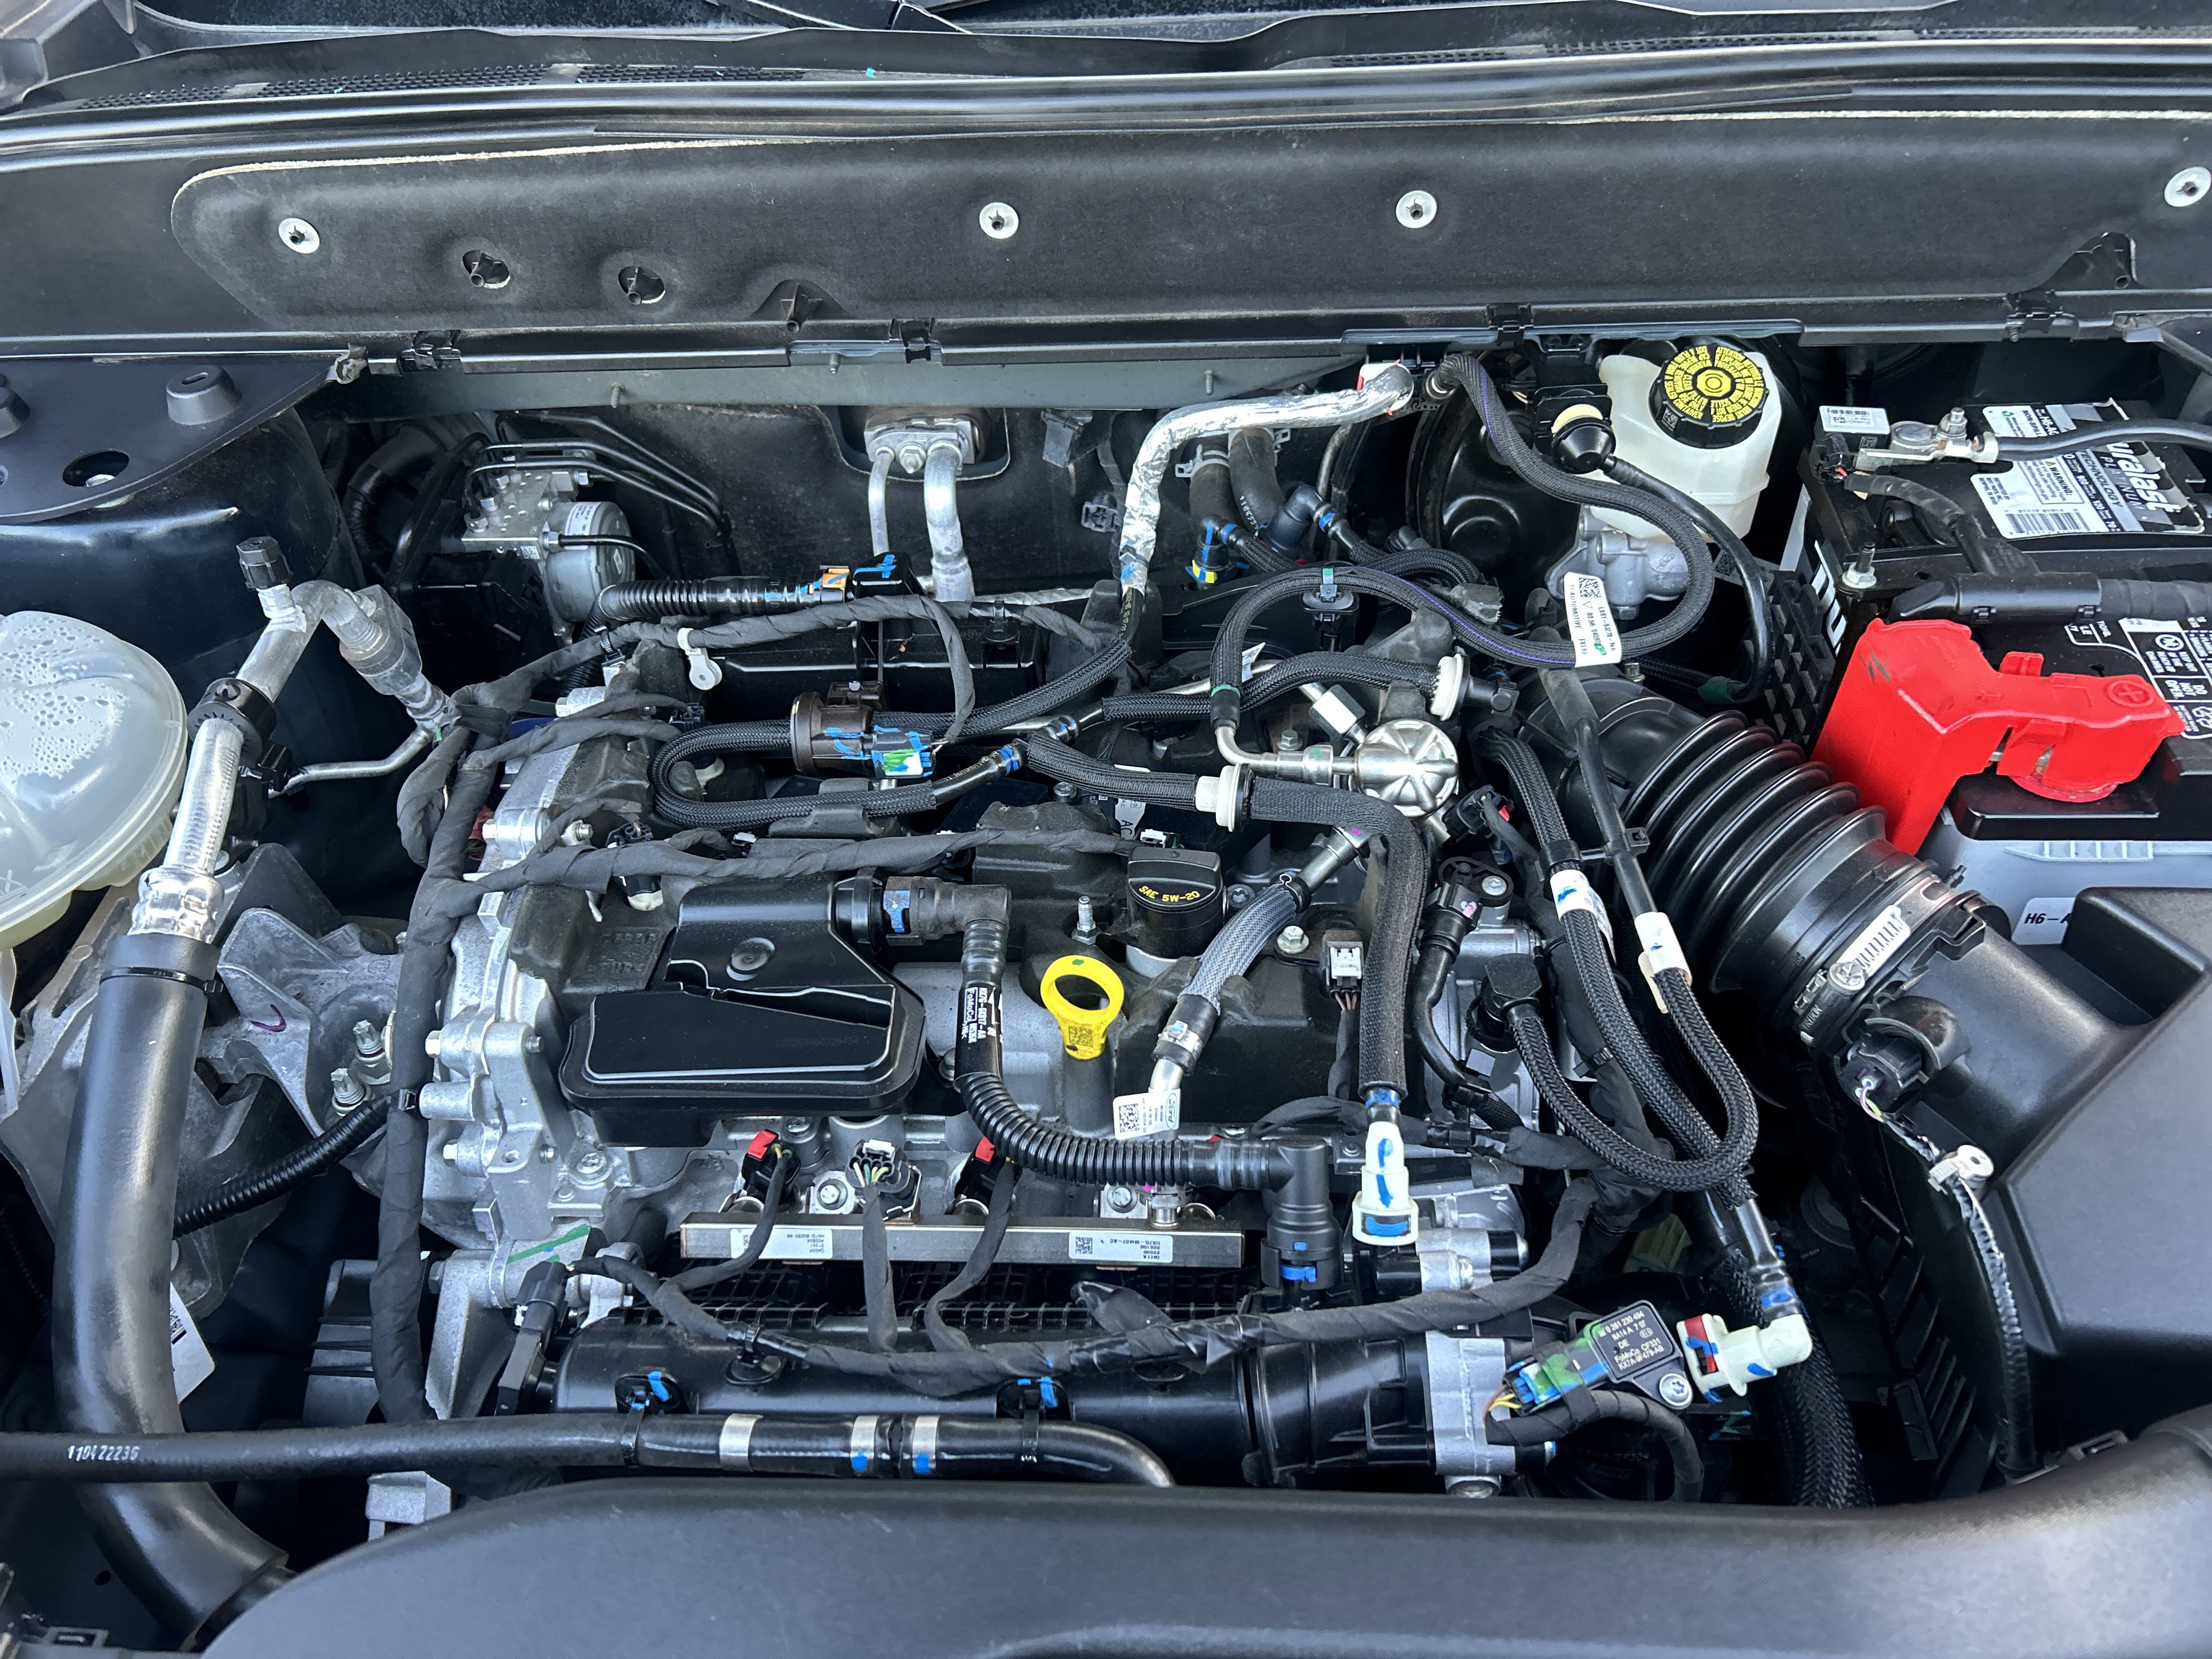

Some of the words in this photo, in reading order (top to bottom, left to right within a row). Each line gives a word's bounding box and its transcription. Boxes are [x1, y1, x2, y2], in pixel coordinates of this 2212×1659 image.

[1674, 351, 1691, 364] FLUID
[1698, 352, 1710, 362] CAP
[1716, 347, 1745, 362] ATTENTION
[1666, 362, 1679, 375] FROM
[1677, 392, 1692, 404] USE
[1673, 398, 1703, 419] CONTAINER
[1687, 400, 1704, 413] ONLY
[1716, 407, 1727, 415] DOT
[1570, 591, 1582, 629] AUTOMOTIVE
[2180, 682, 2197, 697] NOT
[2194, 684, 2208, 695] DO
[1121, 820, 1133, 835] AC
[1138, 885, 1159, 899] SAE
[1161, 890, 1200, 902] 5W-20
[966, 989, 975, 1021] FoMoCo
[1618, 1339, 1630, 1350] DE
